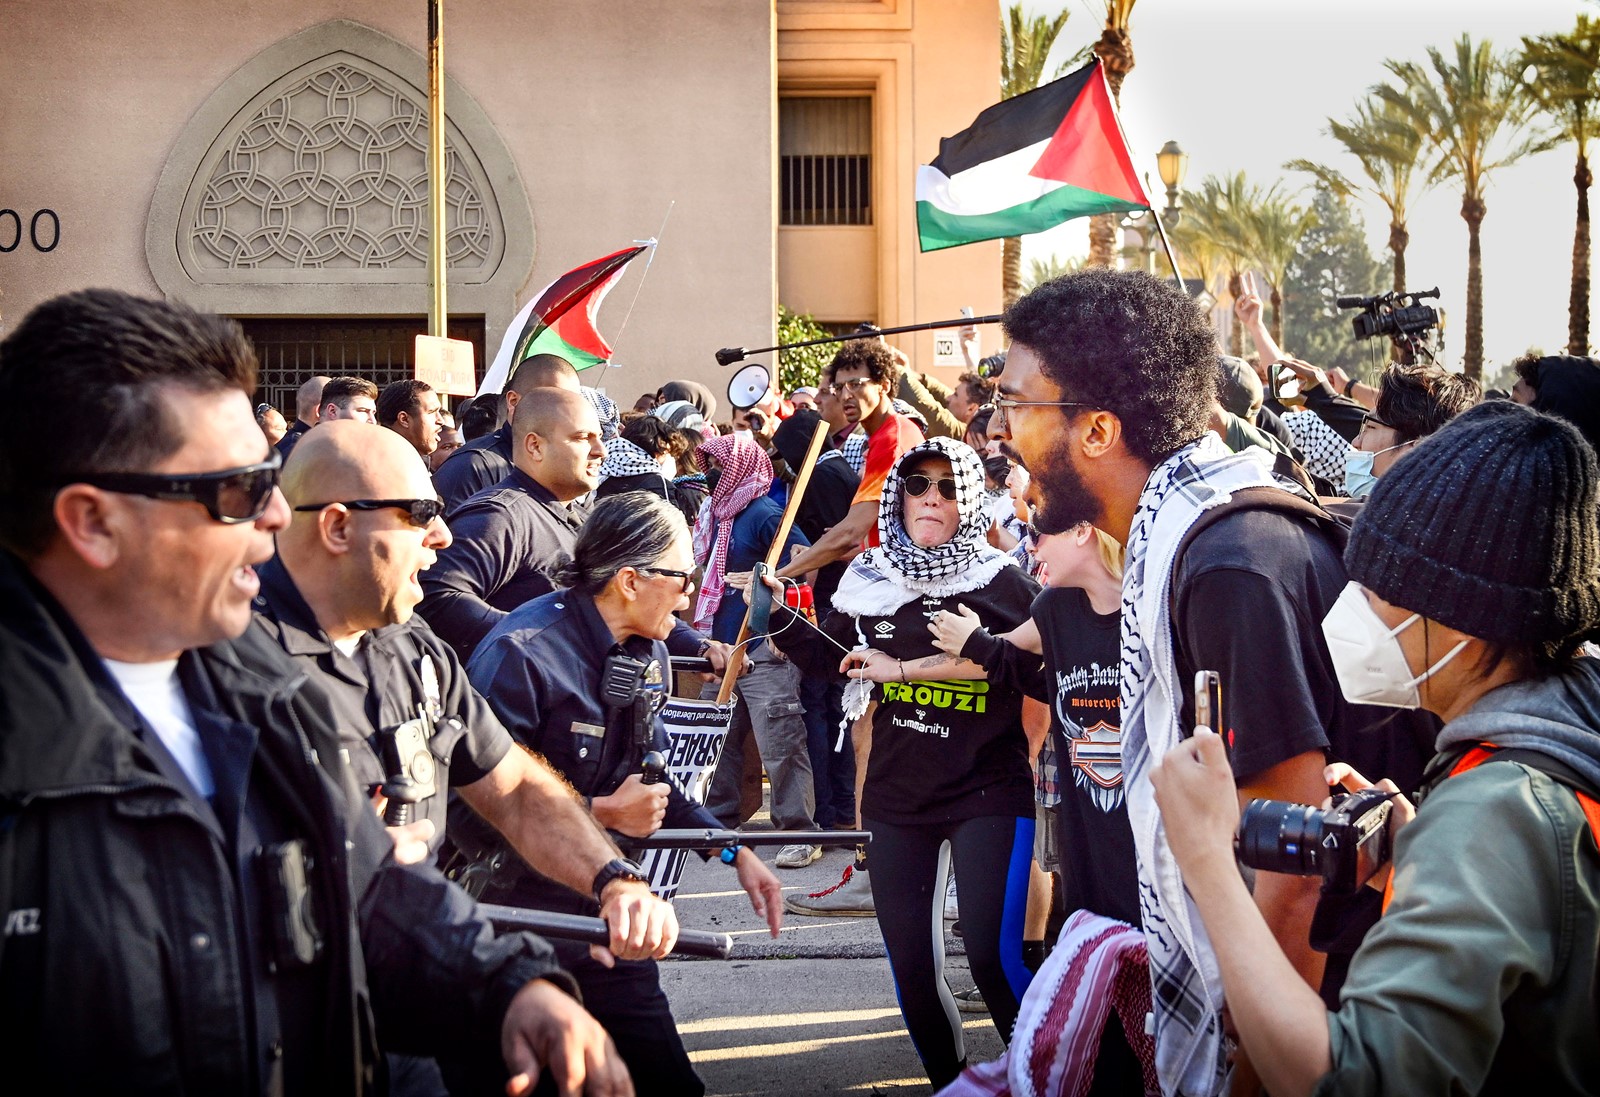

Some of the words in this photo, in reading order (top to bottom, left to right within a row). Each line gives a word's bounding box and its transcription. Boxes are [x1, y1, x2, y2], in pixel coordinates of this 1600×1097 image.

[441, 348, 455, 362] END
[937, 341, 952, 355] NO
[420, 368, 447, 383] ROAD
[662, 708, 696, 721] Liberation
[696, 711, 705, 721] and
